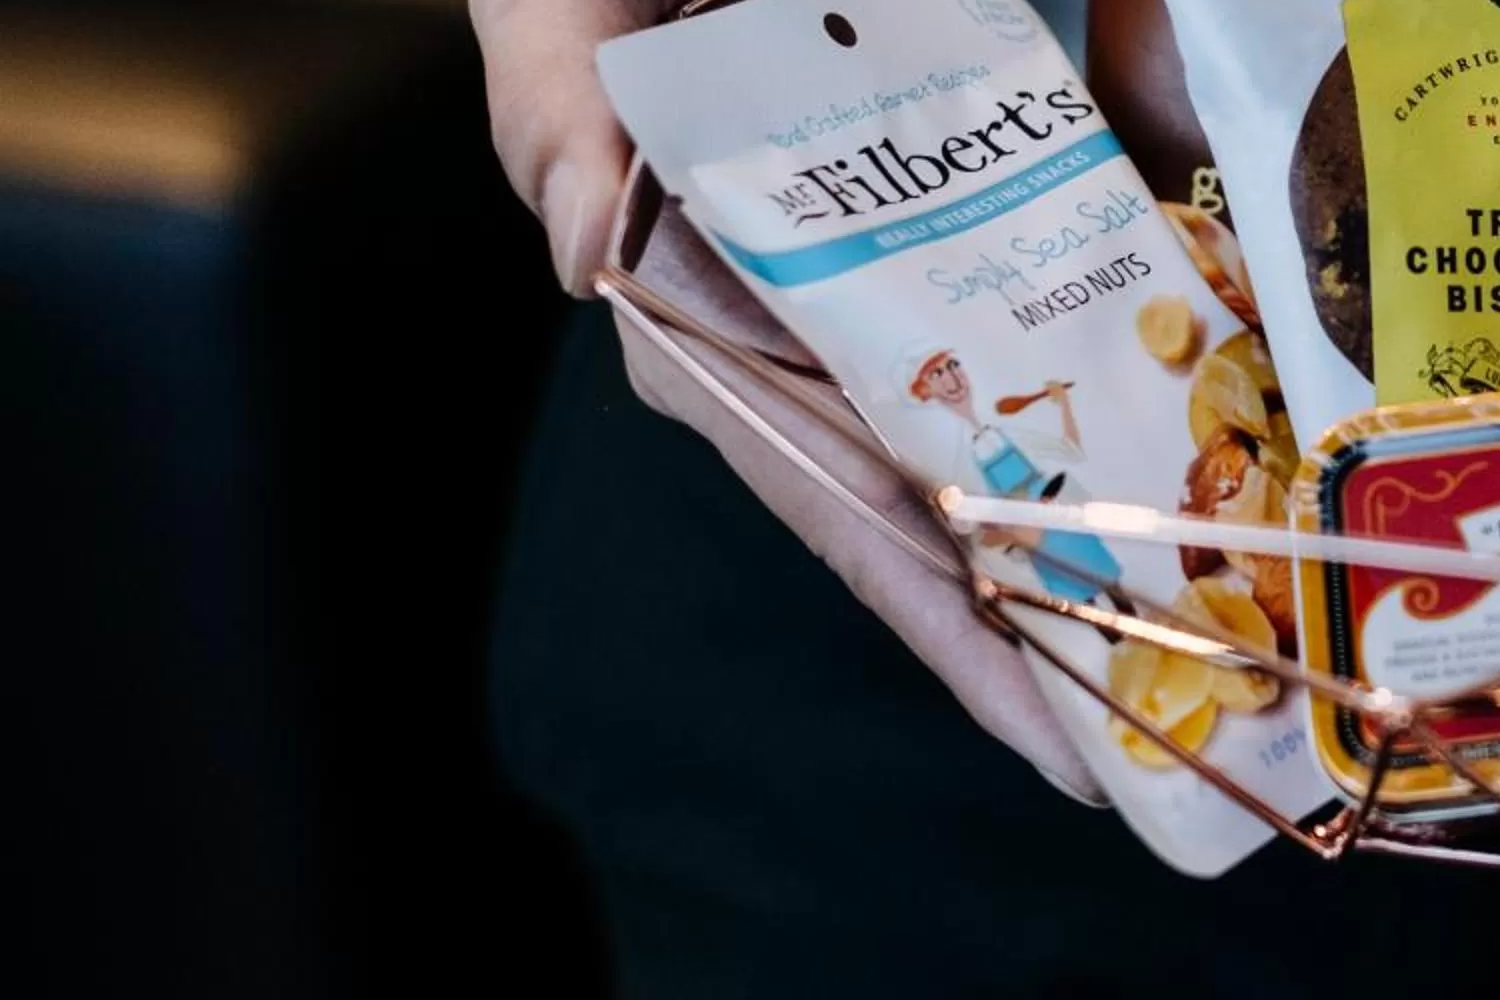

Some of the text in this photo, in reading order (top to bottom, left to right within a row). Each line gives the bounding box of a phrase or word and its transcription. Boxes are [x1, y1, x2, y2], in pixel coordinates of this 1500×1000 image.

[793, 88, 1094, 217] Filbert's
[932, 183, 1029, 233] INTERESTING
[1027, 151, 1092, 188] SNACKS
[1010, 227, 1090, 268] Sea
[1076, 190, 1149, 234] Salt
[1011, 252, 1151, 332] MIXED NUTS
